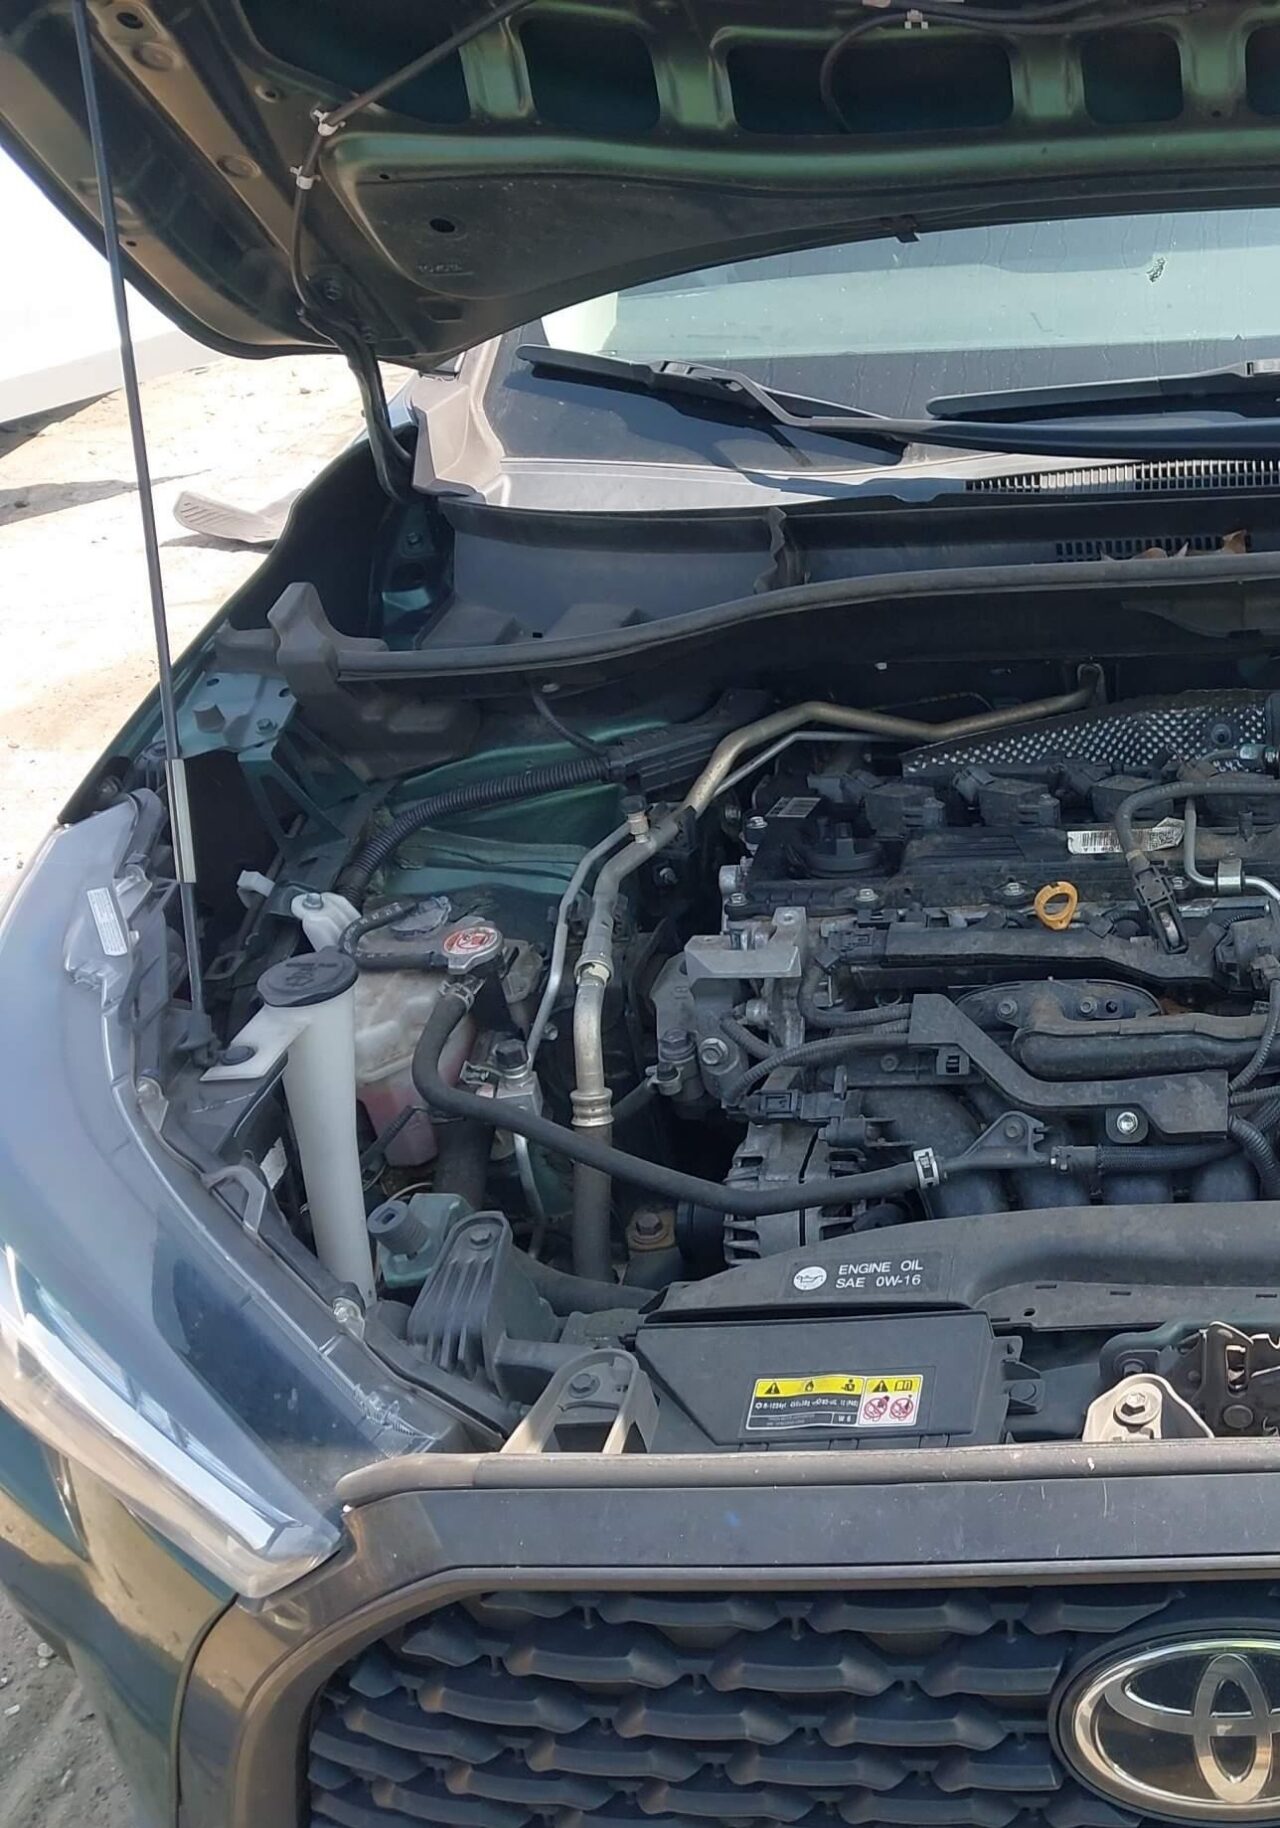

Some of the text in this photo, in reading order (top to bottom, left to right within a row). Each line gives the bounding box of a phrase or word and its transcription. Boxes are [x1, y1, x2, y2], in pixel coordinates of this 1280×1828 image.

[838, 1259, 924, 1276] ENGINE OIL
[835, 1273, 922, 1289] SAE 0W-16
